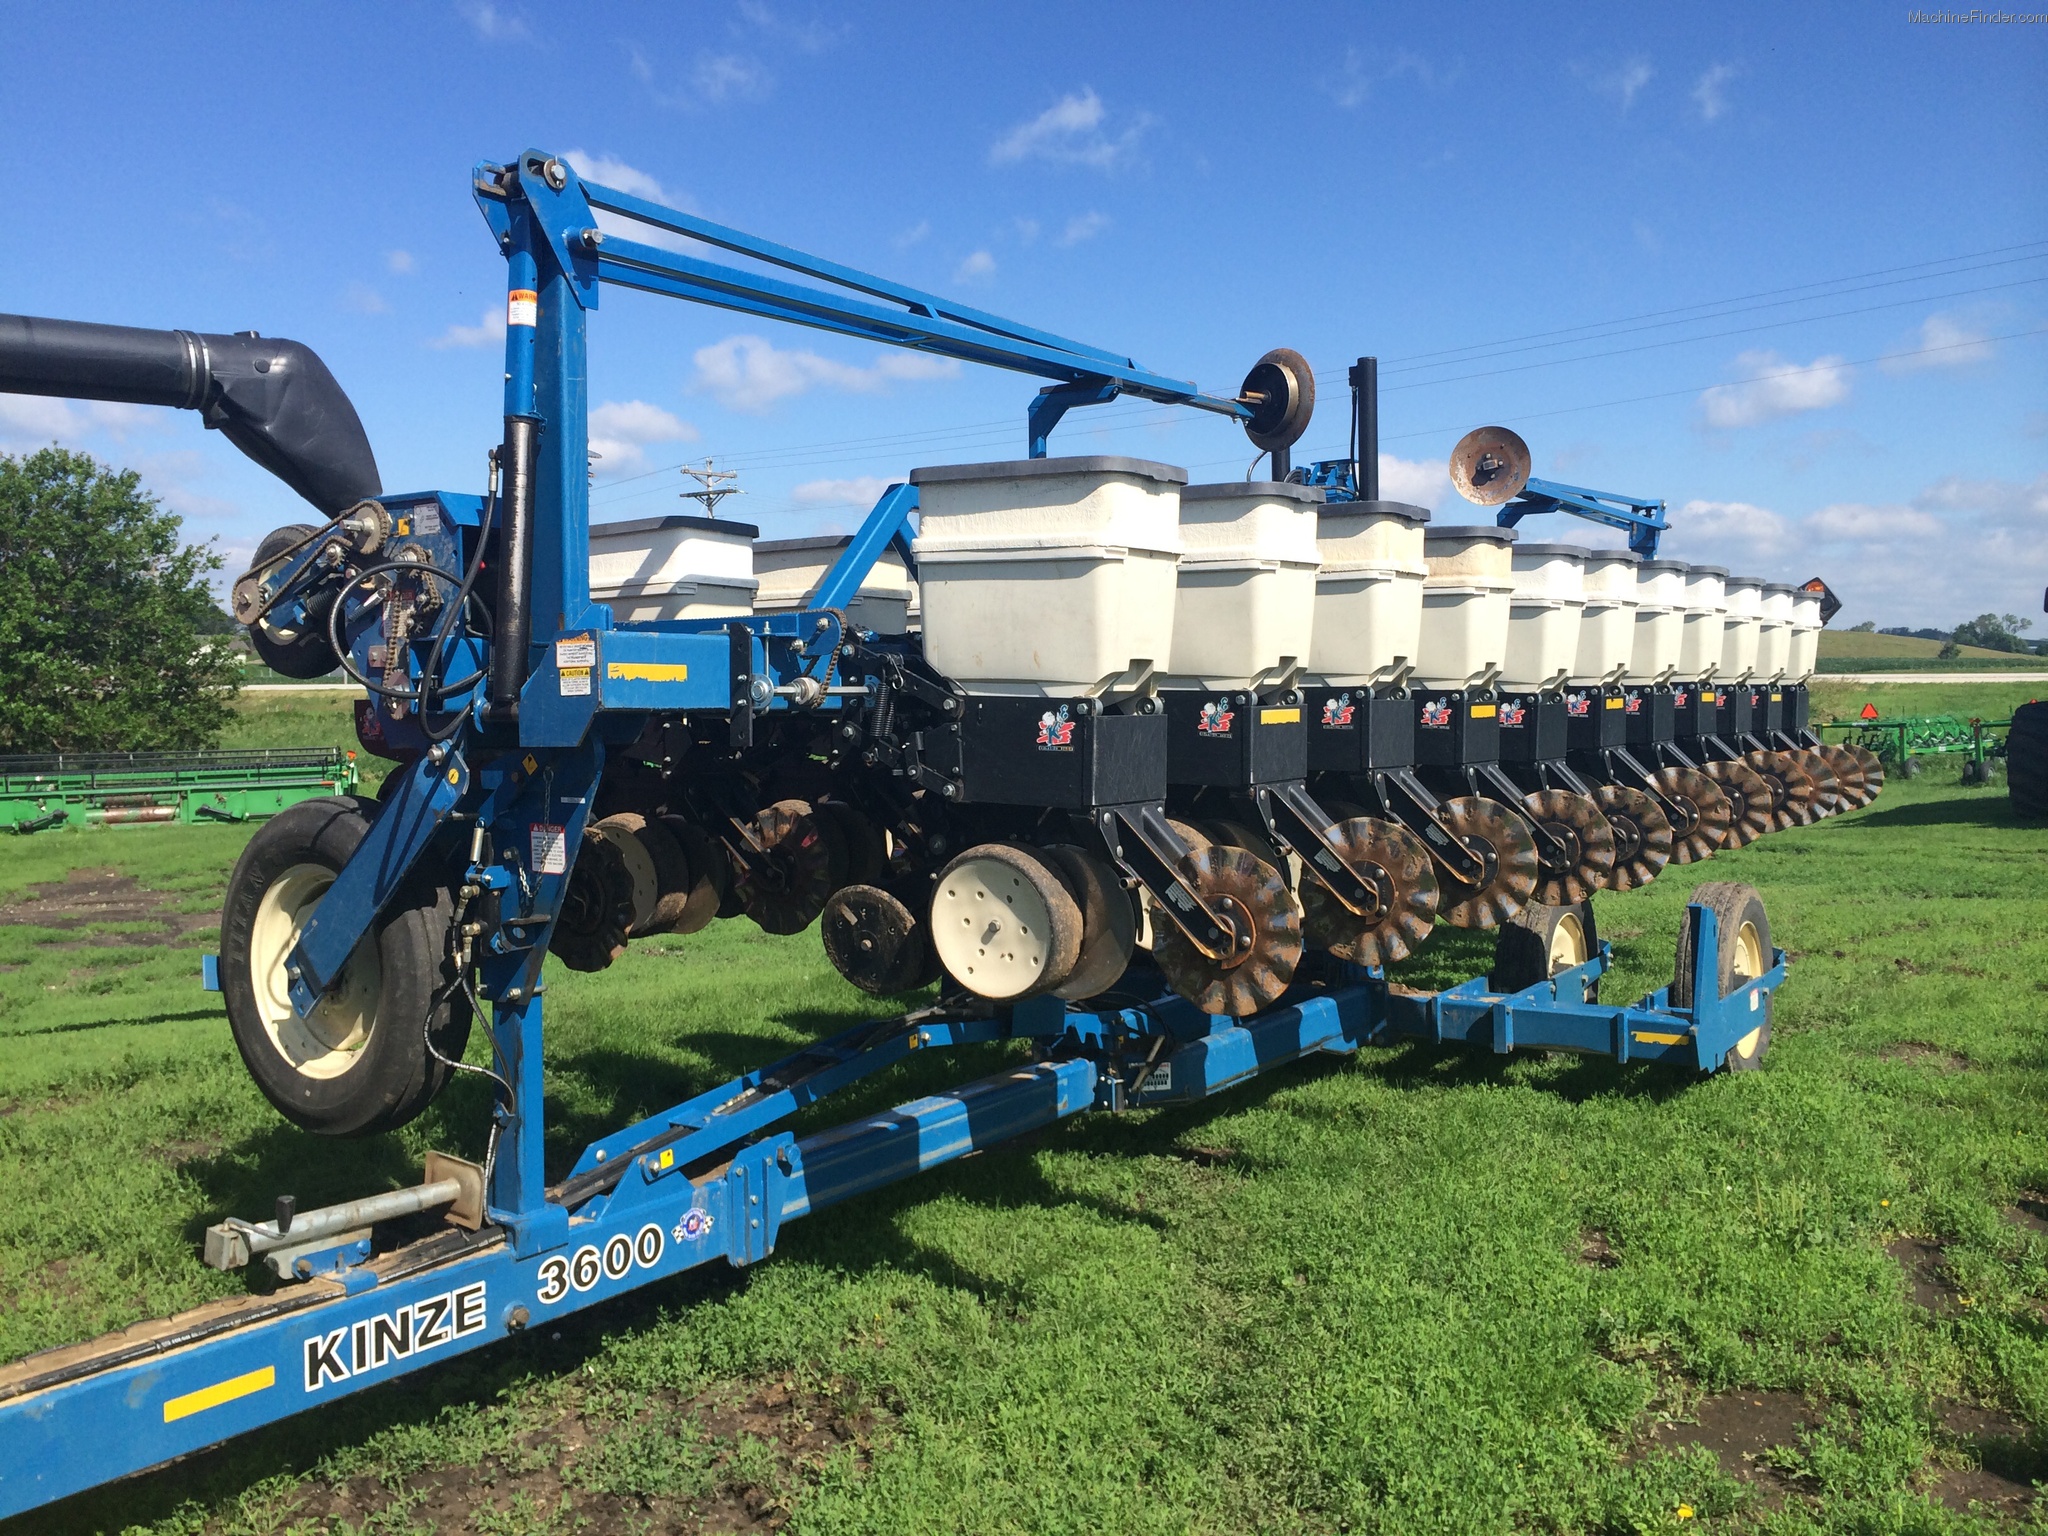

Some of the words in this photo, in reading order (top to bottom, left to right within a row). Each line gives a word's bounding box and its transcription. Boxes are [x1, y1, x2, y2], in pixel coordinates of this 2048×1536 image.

[566, 669, 583, 677] CAUTION
[539, 825, 562, 833] DNGER
[537, 1222, 665, 1304] 3600
[304, 1280, 486, 1393] KINZE
